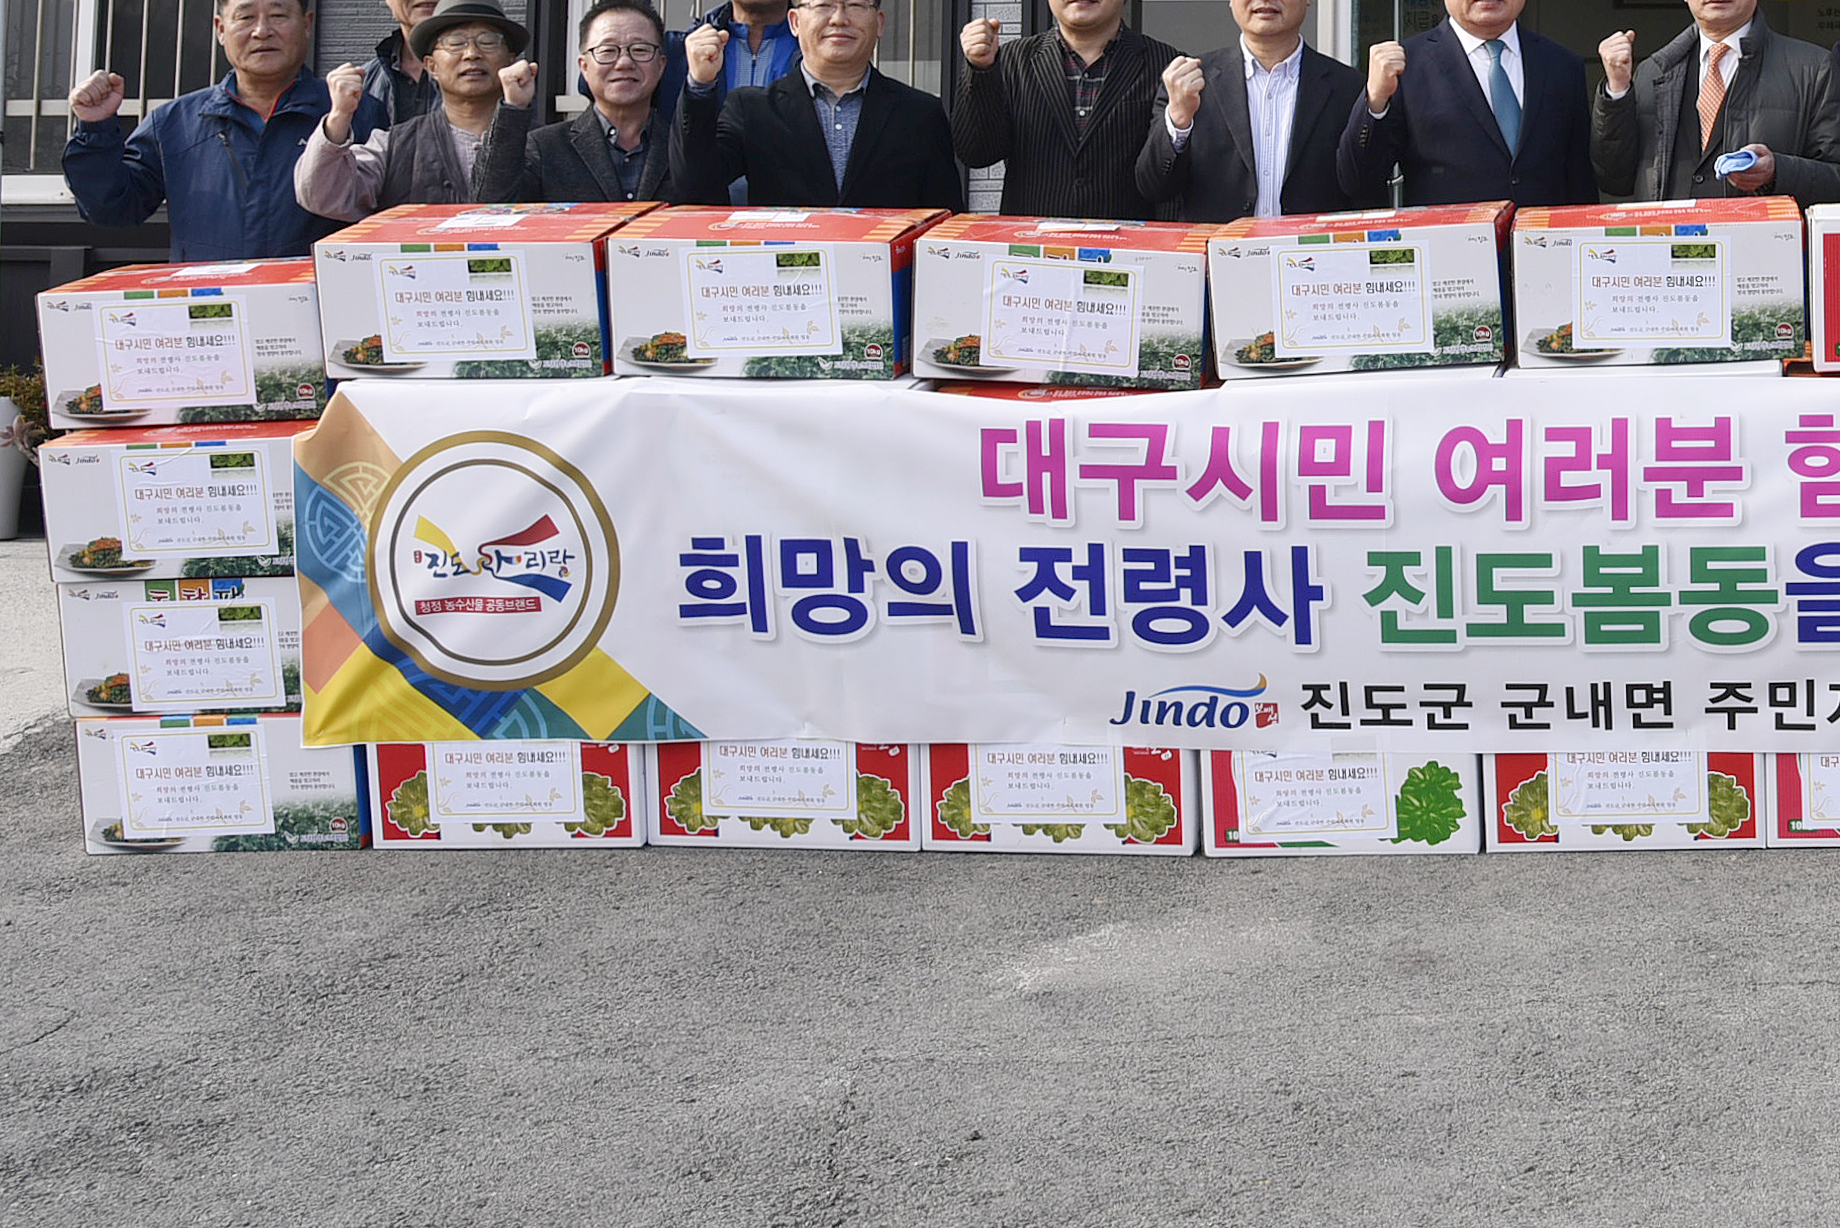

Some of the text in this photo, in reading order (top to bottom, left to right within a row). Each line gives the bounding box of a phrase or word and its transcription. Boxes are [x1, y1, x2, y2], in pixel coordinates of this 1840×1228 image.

[1291, 280, 1415, 296] 대구시민 여러분 힘내세요!!!
[1592, 275, 1715, 288] 대구시민 여러분 힘내세요!!!
[394, 289, 515, 303] 대구시민 여러분 힘내세요!!!
[701, 283, 822, 298] 대구시민 여러분 힘내세요!!!
[1002, 295, 1126, 316] 대구시민 여러분 힘내세요!!!
[114, 334, 235, 351] 대구시민 여러분 힘내세요!!!
[980, 418, 1387, 522] 대구시민
[1435, 416, 1743, 522] 여러분
[134, 484, 257, 500] 대구시민 여러분 힘내세요!!!
[679, 535, 976, 635] 희망의
[1015, 543, 1324, 645] 전령사
[420, 600, 537, 613] 청정 농수산물 공동브랜드
[144, 636, 265, 652] 대구시민 여러분 힘내세요!!!
[1109, 690, 1250, 729] Jindo
[1301, 681, 1473, 730] 진도군
[1500, 681, 1675, 731] 군내면
[445, 752, 482, 764] 대구시민
[486, 752, 513, 763] 여러분
[719, 745, 756, 757] 대구시민
[760, 746, 788, 758] 여러분
[987, 753, 1024, 764] 대구시민
[1028, 753, 1055, 764] 여러분
[135, 767, 172, 779] 대구시민
[175, 766, 203, 778] 여러분
[1254, 770, 1293, 783] 대구시민
[1296, 769, 1324, 781] 여러분
